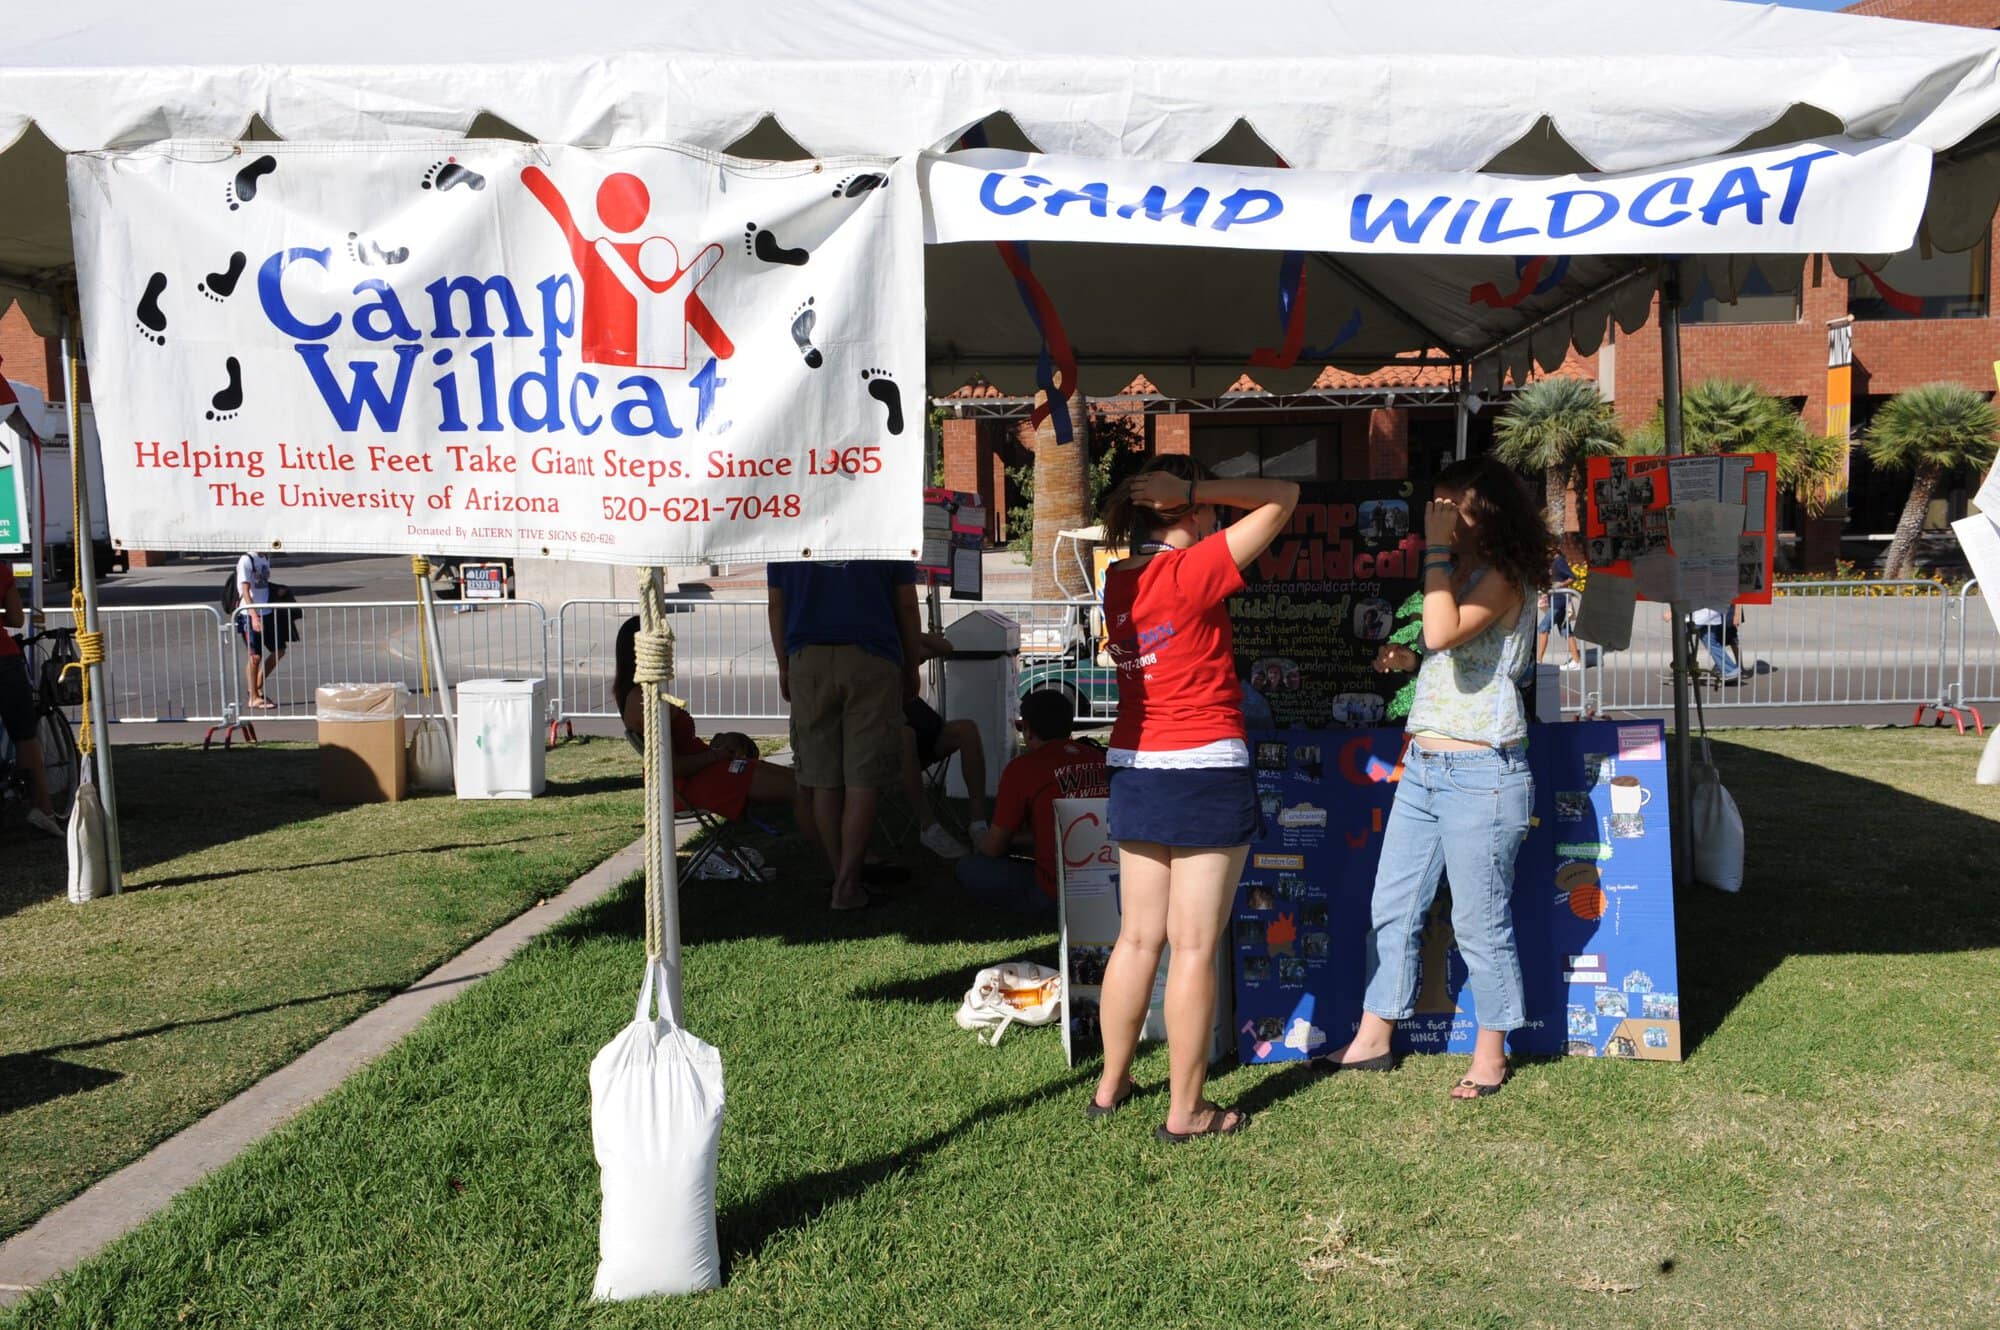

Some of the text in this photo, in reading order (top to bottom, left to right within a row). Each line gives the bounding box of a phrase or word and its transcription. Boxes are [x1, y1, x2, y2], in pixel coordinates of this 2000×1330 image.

[978, 149, 1838, 245] CAMP WILDCAT
[257, 246, 576, 352] Camp
[293, 342, 733, 438] Wildcat
[135, 441, 882, 488] Helping Little Feet Take Giant Steps. Since 1965
[209, 484, 801, 523] The University of Arizona 520-621-7048
[407, 525, 451, 536] Donated
[455, 526, 467, 541] By
[471, 527, 545, 541] ALTERNTIVE
[547, 530, 577, 542] SIGNS
[1258, 532, 1426, 580] Wildcat
[1232, 634, 1272, 645] edicated
[1233, 646, 1260, 661] ollege
[1054, 764, 1072, 777] WE
[1056, 769, 1106, 793] WIL
[1397, 1020, 1421, 1031] little
[1410, 1032, 1440, 1043] SINCE
